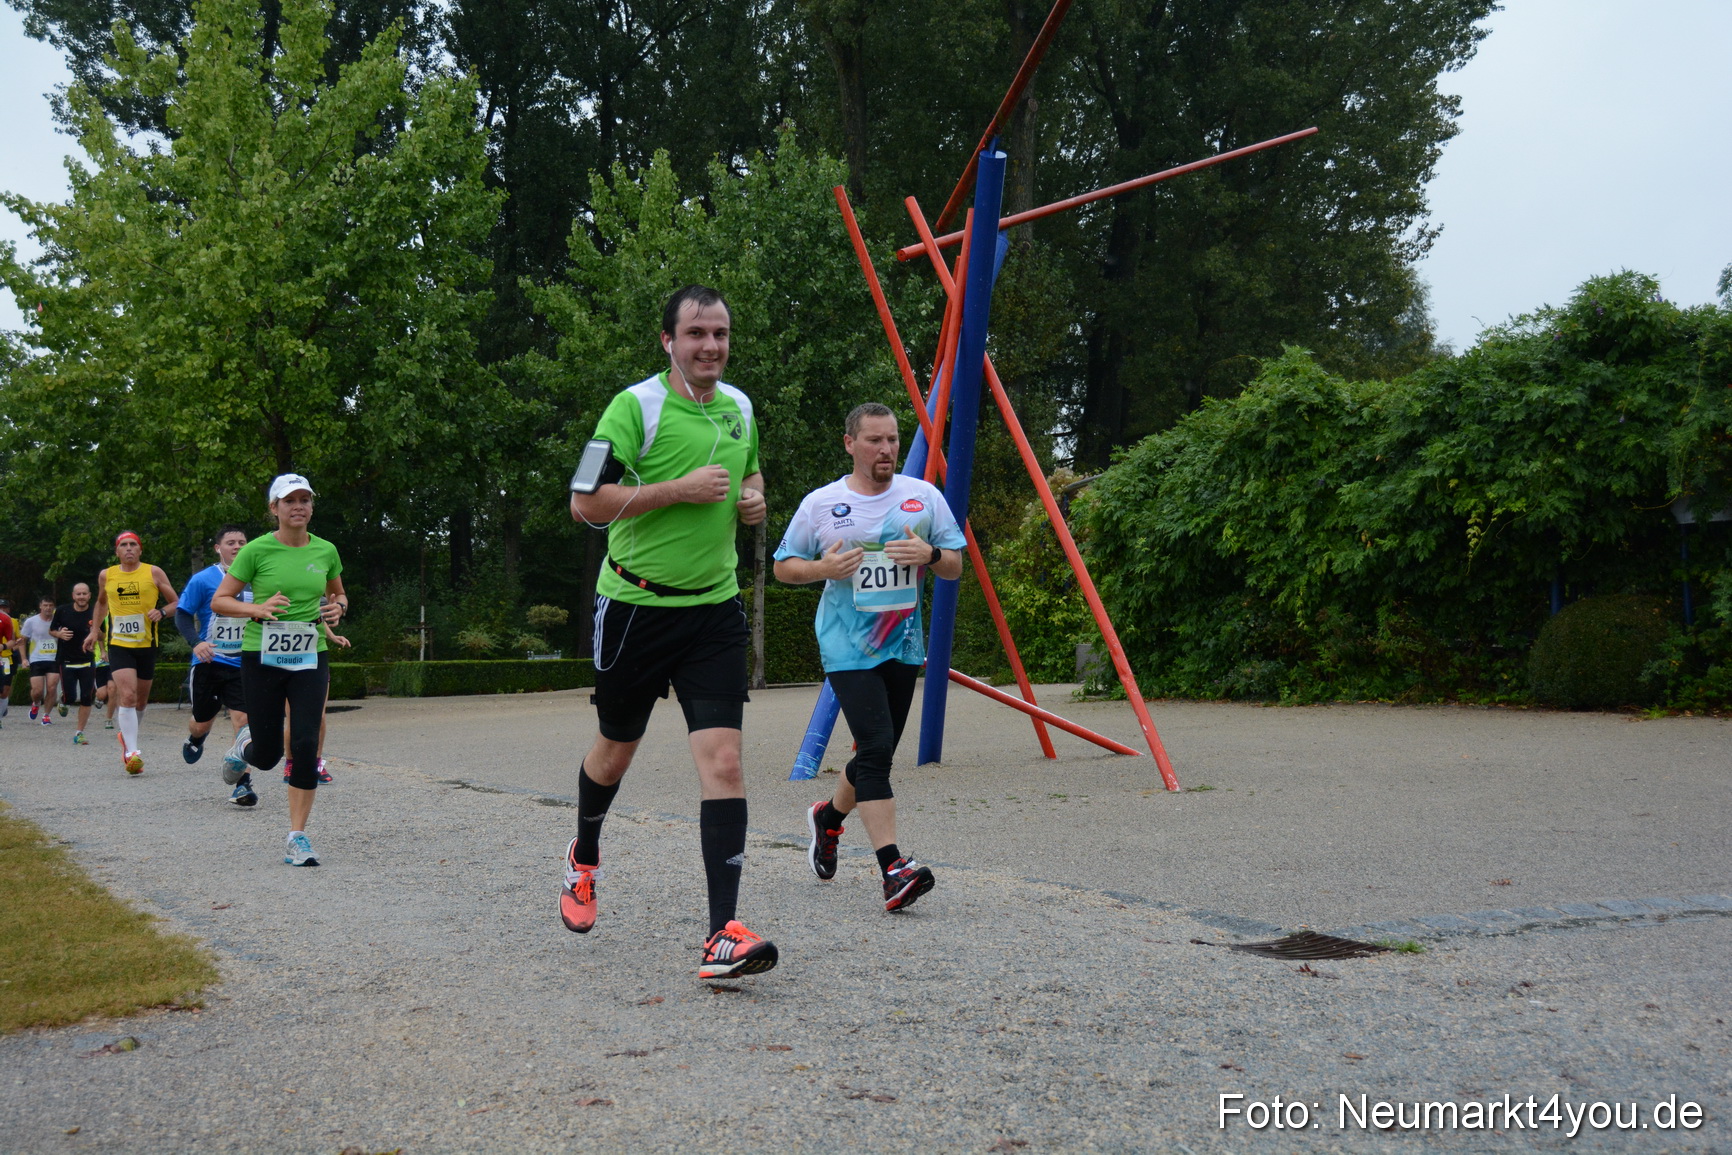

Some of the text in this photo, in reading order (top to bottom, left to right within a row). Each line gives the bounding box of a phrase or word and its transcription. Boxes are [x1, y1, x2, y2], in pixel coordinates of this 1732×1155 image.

[860, 564, 911, 589] 2011
[119, 621, 140, 634] 209
[268, 633, 315, 652] 2527
[276, 656, 303, 665] Claudia
